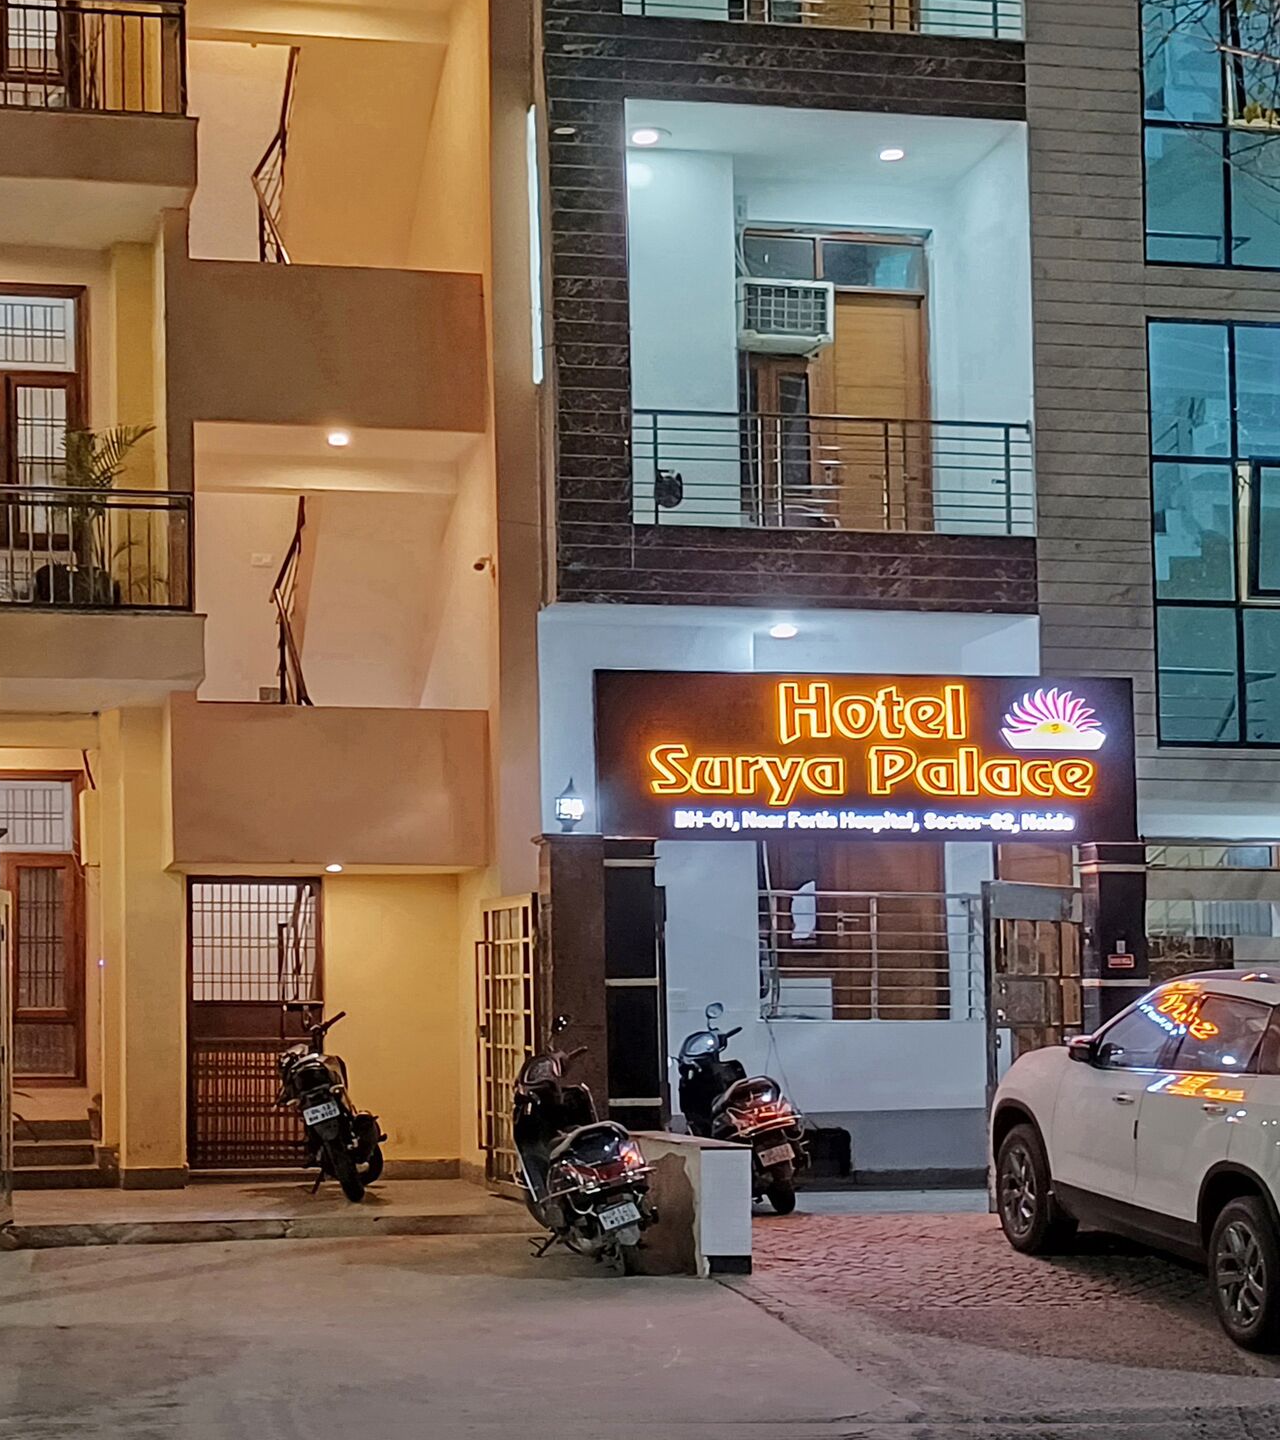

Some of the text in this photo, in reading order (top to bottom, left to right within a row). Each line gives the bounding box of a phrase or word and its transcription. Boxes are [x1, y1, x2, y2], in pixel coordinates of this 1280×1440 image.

[777, 681, 968, 744] Hotel
[648, 743, 1097, 806] Surya Palace
[742, 810, 787, 829] Near
[788, 810, 838, 829] Fortis
